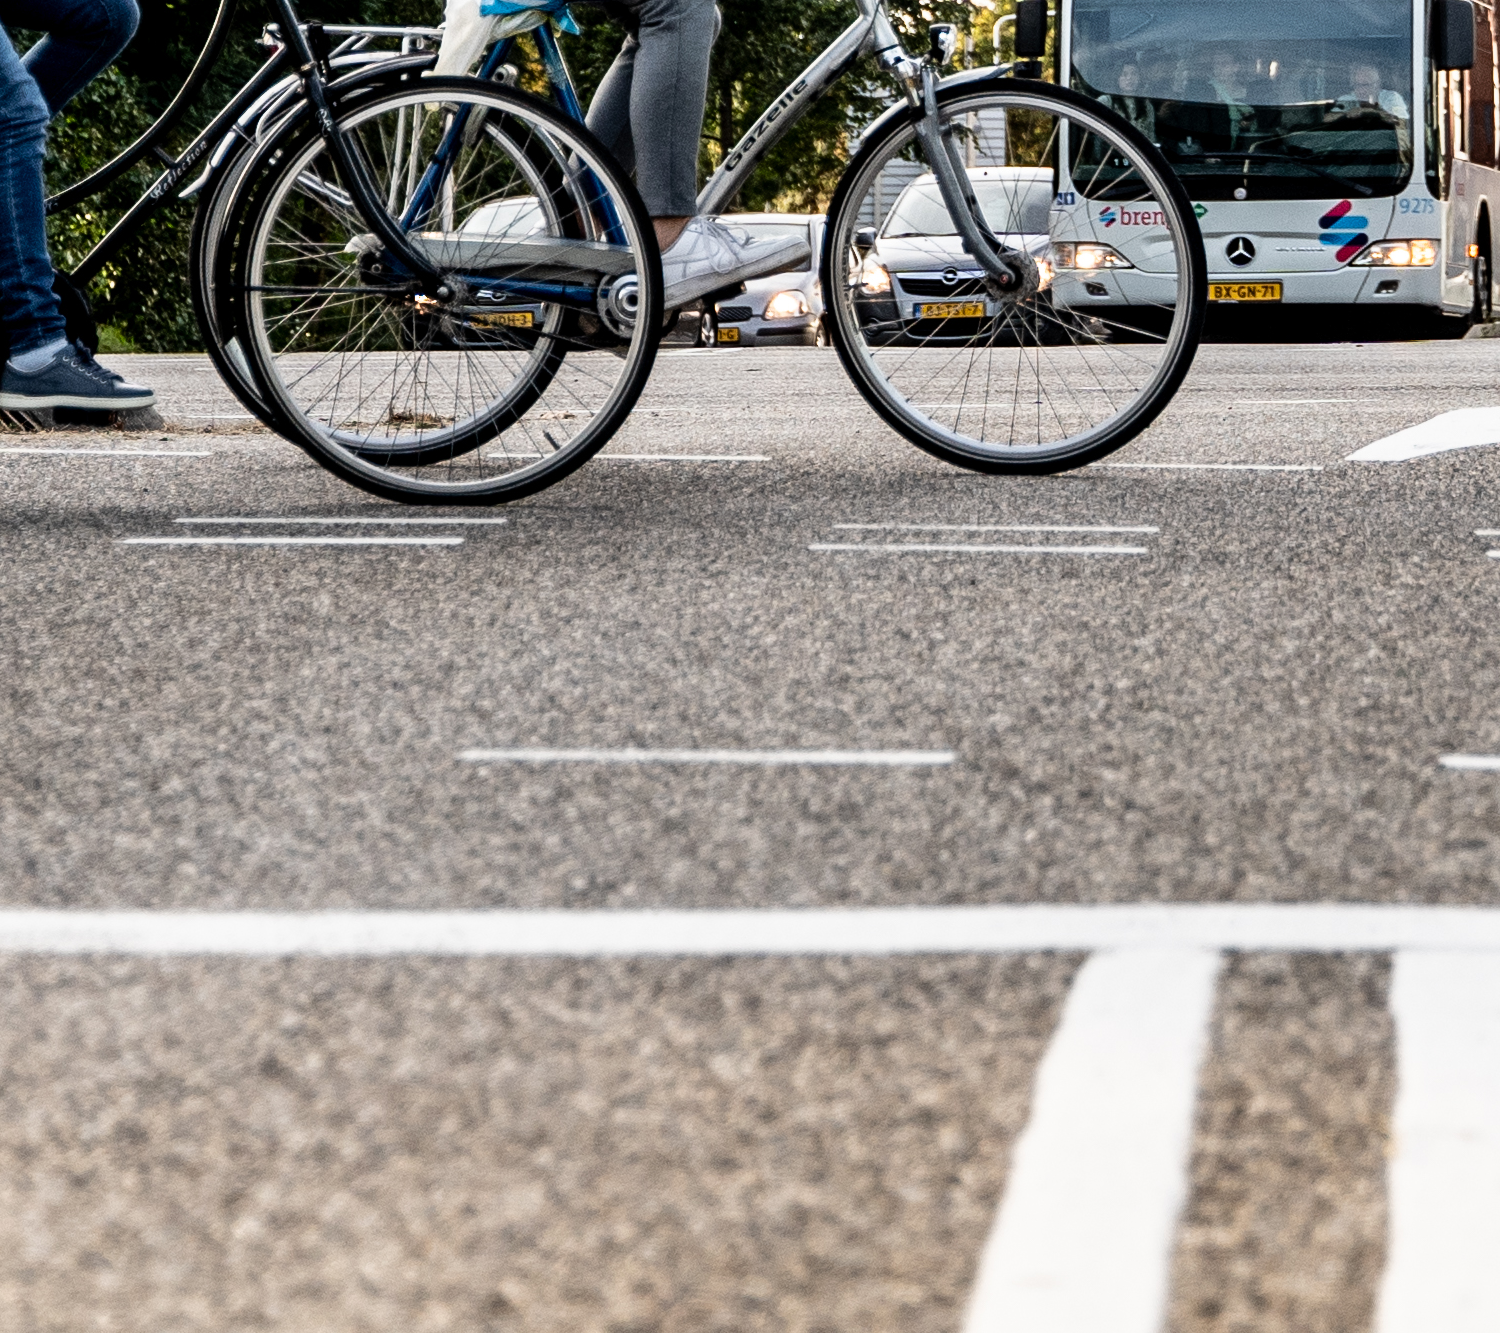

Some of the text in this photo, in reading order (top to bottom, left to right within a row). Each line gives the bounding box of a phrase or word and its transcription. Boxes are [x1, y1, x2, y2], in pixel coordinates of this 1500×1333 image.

[724, 78, 809, 172] Gazelle
[1400, 198, 1435, 215] 9275
[1213, 284, 1276, 299] BX-GN-71
